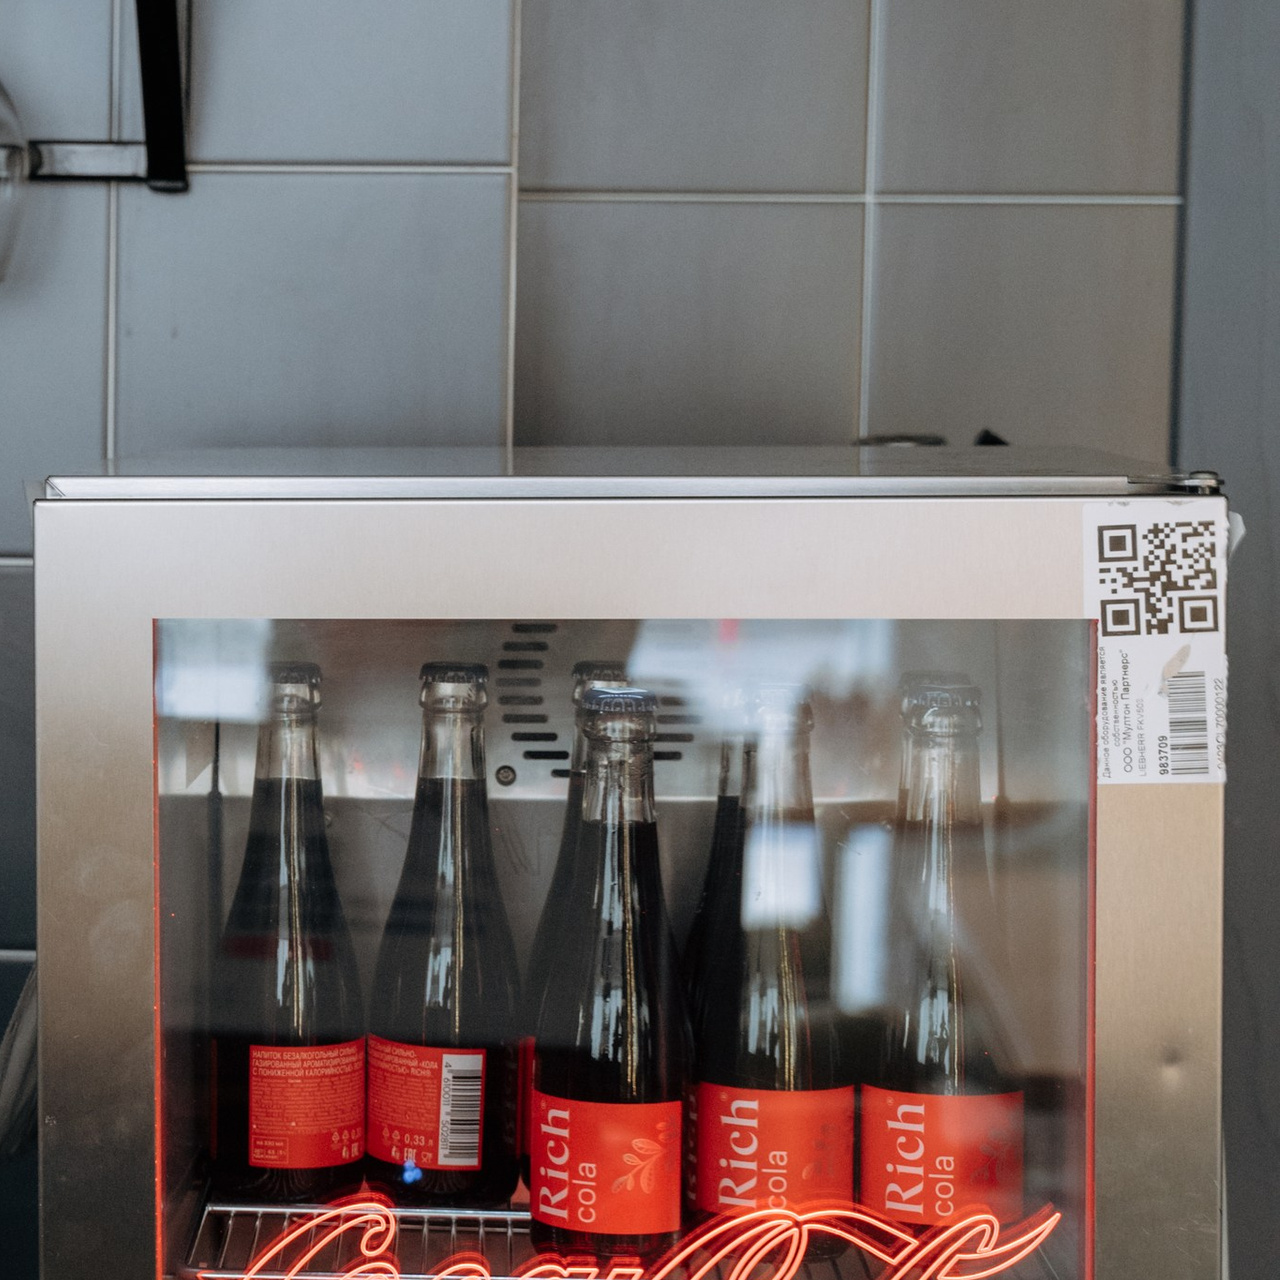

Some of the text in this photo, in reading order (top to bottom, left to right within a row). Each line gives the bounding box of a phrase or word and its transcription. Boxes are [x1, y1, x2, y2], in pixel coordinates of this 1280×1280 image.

[1099, 646, 1111, 779] Данное оборудование является
[1112, 680, 1120, 747] собственностью
[1123, 748, 1133, 773] ООО
[1138, 734, 1147, 777] LIEBHERR
[1158, 736, 1169, 776] 983709
[252, 1050, 282, 1059] НАПИТОК
[283, 1048, 339, 1060] БЕЗАЛКОГОЛЬНЫЙ
[252, 1059, 302, 1068] ГАЗИРОВАННЫЙ
[252, 1067, 257, 1076] С
[258, 1067, 304, 1077] ПОНИЖЕННОЙ
[442, 1077, 450, 1107] 610011
[404, 1133, 425, 1146] 0,33
[441, 1119, 449, 1150] 502811
[718, 1099, 759, 1208] Rich
[539, 1107, 570, 1220] Rich
[762, 1150, 787, 1211] cola
[885, 1104, 925, 1217] Rich
[572, 1162, 597, 1223] cola
[928, 1155, 954, 1217] cola
